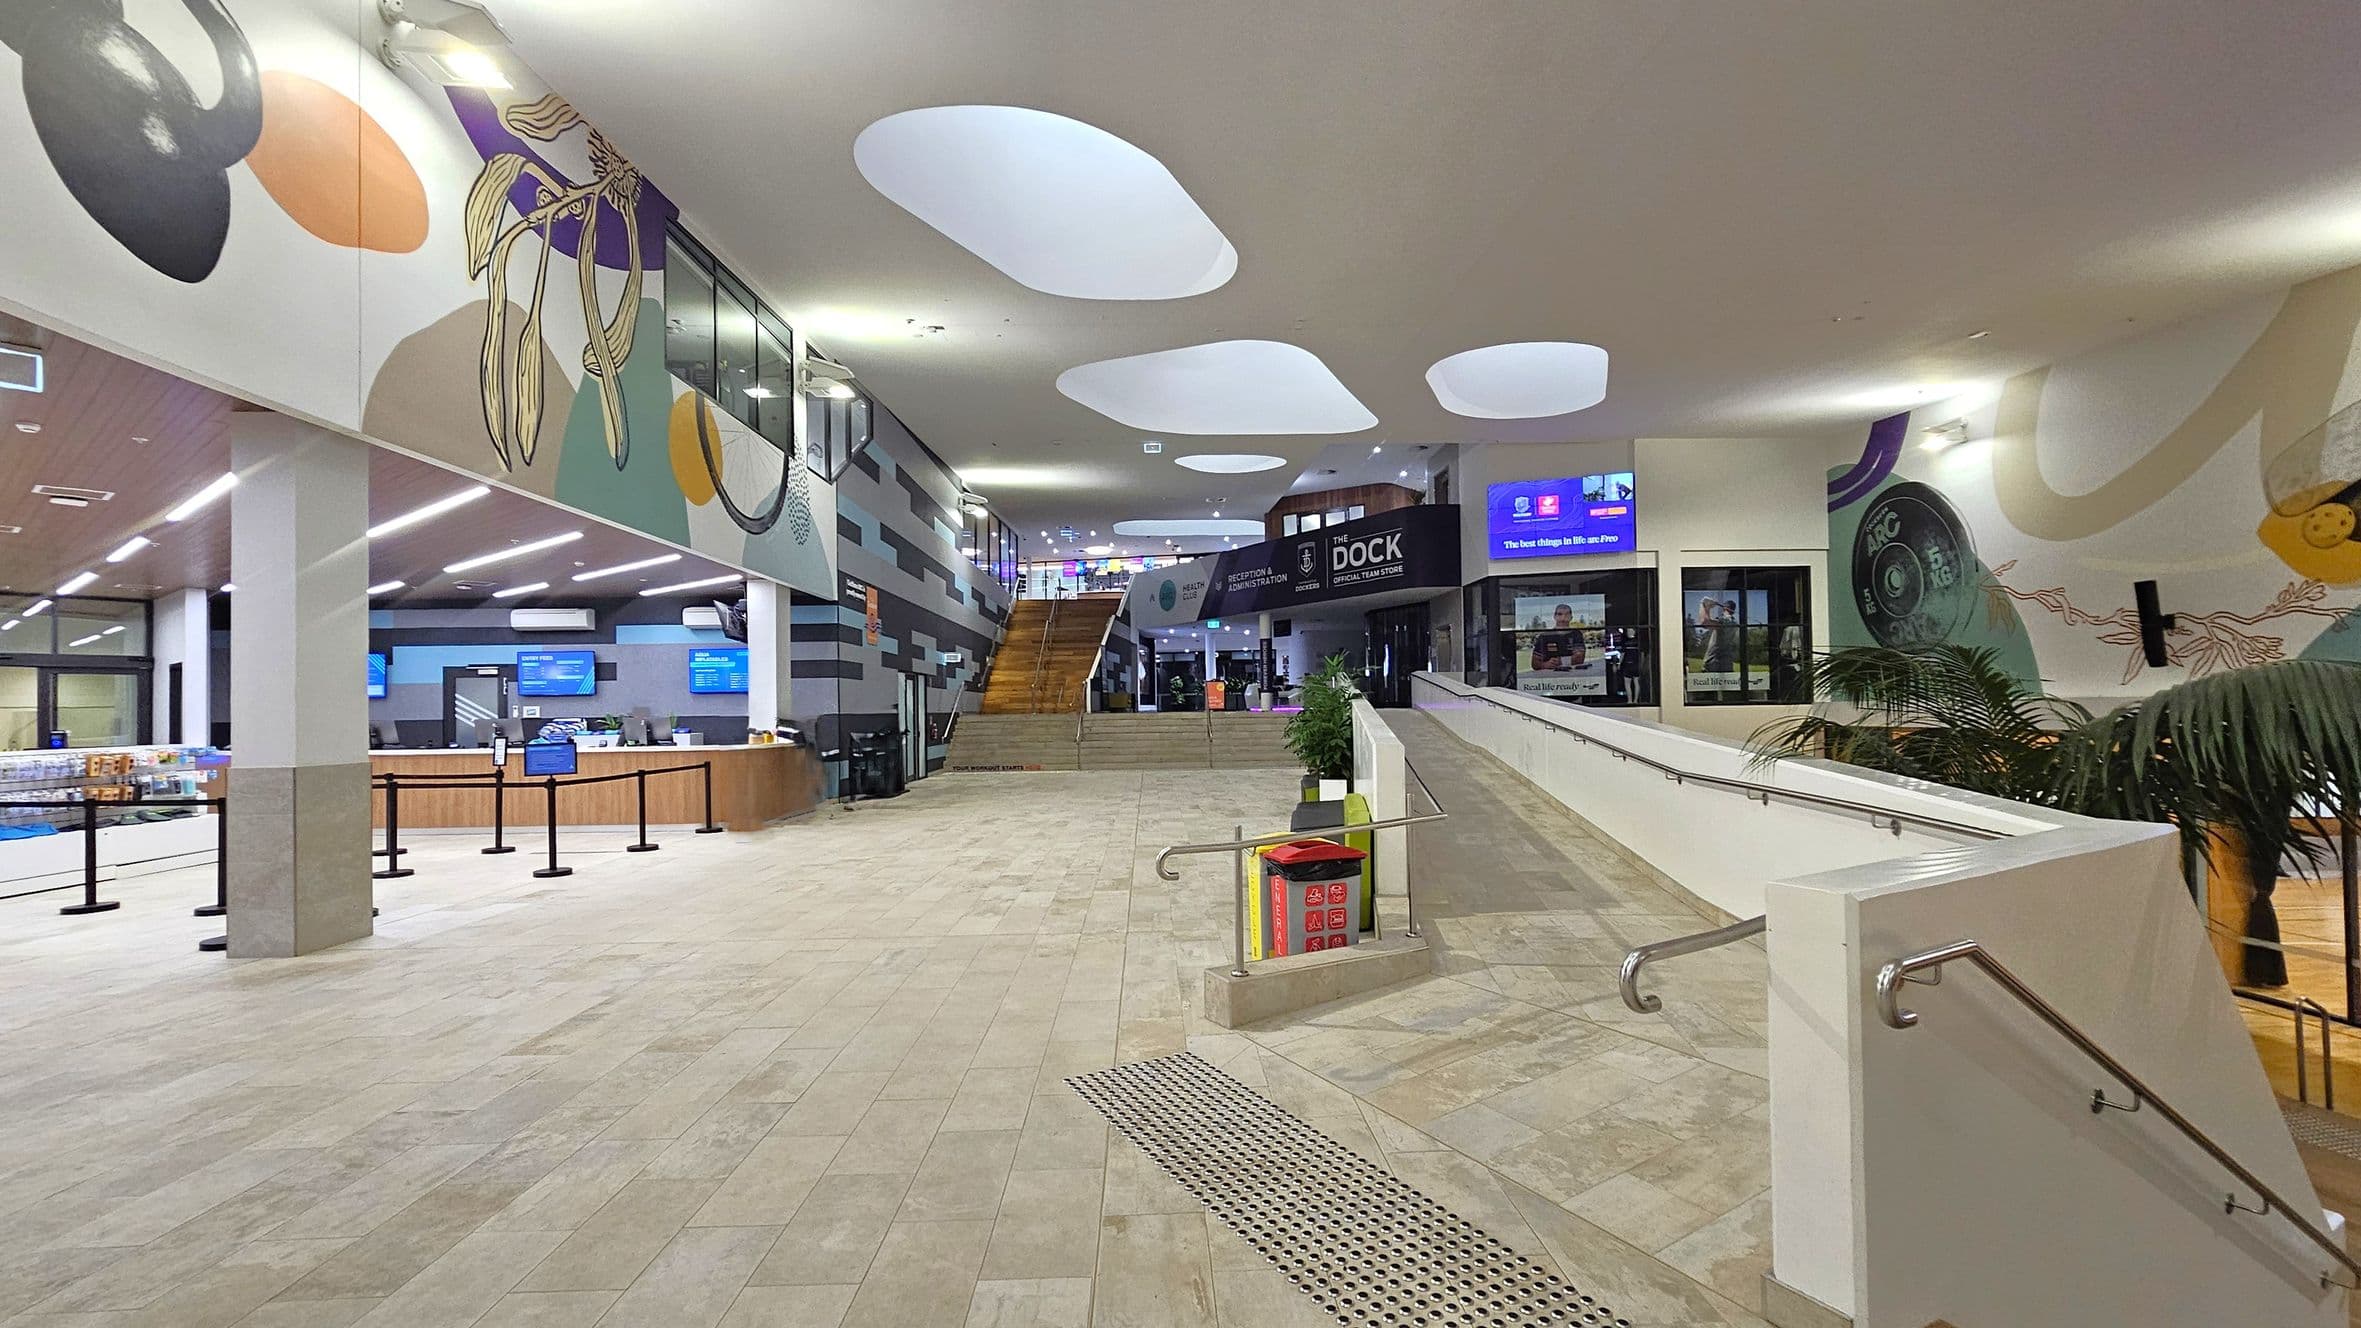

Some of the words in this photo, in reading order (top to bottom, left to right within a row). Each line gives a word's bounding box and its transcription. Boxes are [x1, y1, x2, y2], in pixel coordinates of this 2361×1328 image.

[1333, 534, 1349, 545] THE
[1867, 511, 1900, 558] ARC
[1504, 540, 1519, 549] The
[1520, 539, 1536, 548] best
[1537, 537, 1562, 548] things
[1564, 536, 1572, 545] in
[1573, 535, 1587, 545] life
[1332, 533, 1403, 571] DOCK
[1927, 546, 1943, 570] 5
[1228, 567, 1266, 582] RECEPTION
[1333, 573, 1361, 584] OFFICIAL
[1362, 569, 1380, 579] TEAM
[1381, 565, 1403, 576] STORE
[1930, 566, 1954, 589] KG
[1182, 582, 1205, 592] HEALTH
[1228, 573, 1288, 592] ADMINISTRATION
[1295, 583, 1320, 592] DOCKERS
[1182, 591, 1198, 600] CLUB
[1863, 588, 1872, 602] 5
[1523, 683, 1541, 691] Real
[1542, 682, 1556, 691] life
[1556, 681, 1580, 692] ready
[1693, 677, 1710, 686] Real
[1710, 677, 1723, 685] life
